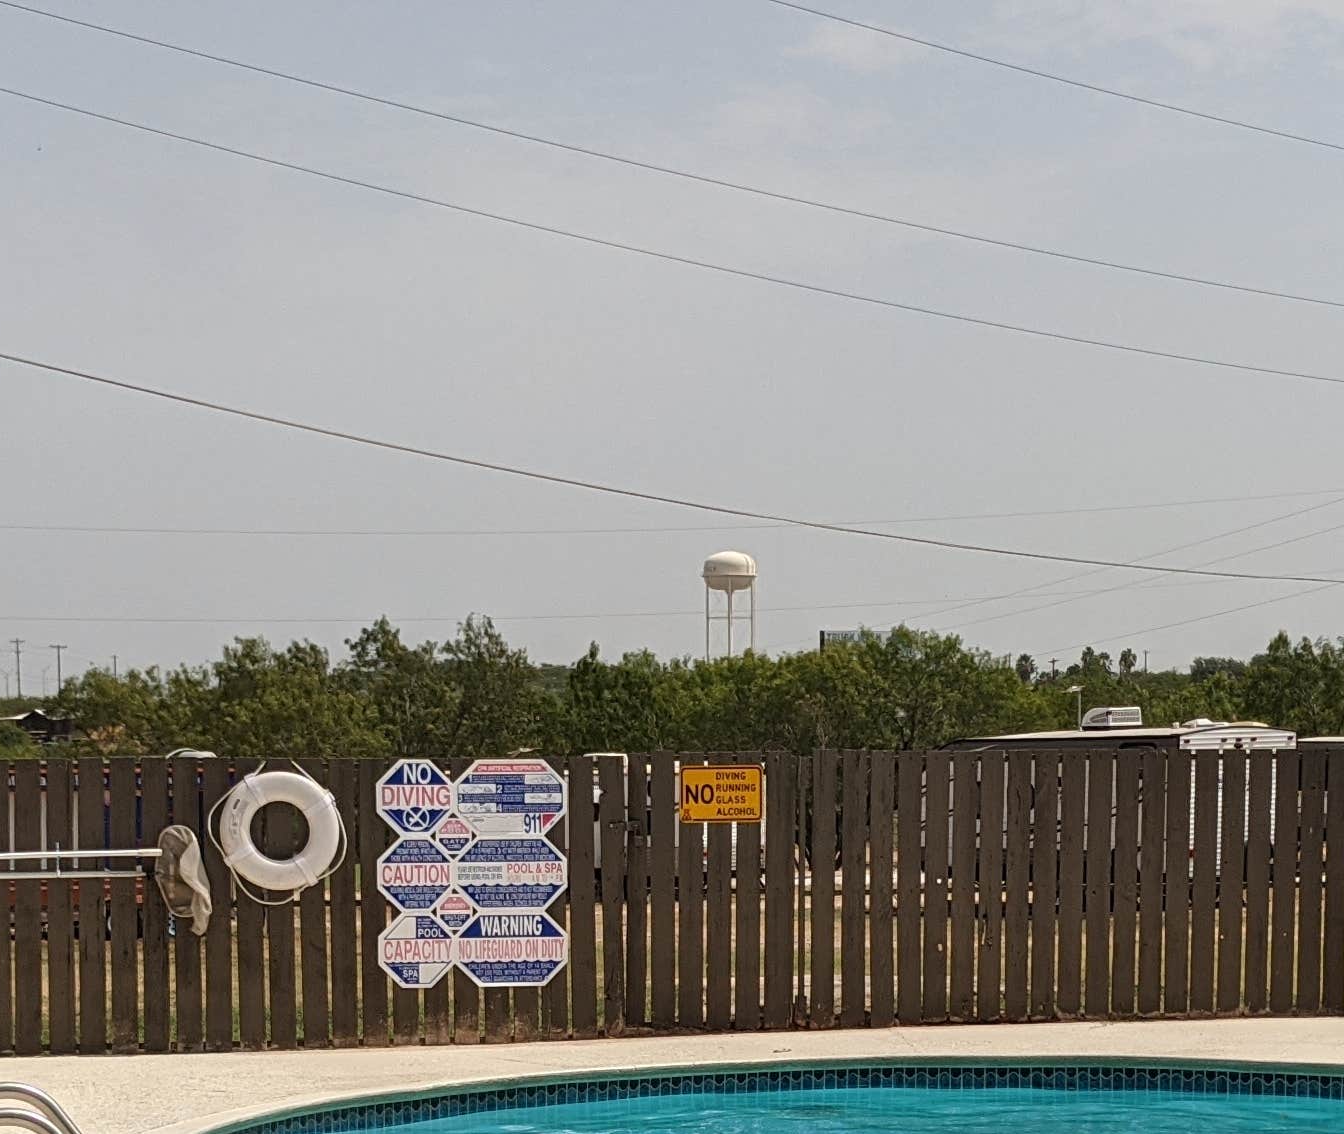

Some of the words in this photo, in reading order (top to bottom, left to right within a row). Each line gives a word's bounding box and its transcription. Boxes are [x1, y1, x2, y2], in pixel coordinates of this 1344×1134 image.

[403, 763, 432, 785] NO
[716, 772, 746, 780] DIVING
[496, 785, 503, 793] 2
[685, 784, 714, 804] NO
[716, 784, 757, 792] RUNNING
[381, 786, 451, 806] DIVING
[716, 796, 746, 804] GLASS
[716, 808, 757, 816] ALCOHOL
[523, 814, 542, 833] 911
[382, 865, 450, 884] CAUTION
[507, 863, 533, 873] POOL
[535, 863, 543, 873] &
[544, 862, 563, 872] SPA
[417, 928, 444, 938] POOL
[479, 915, 543, 936] WARNING
[384, 940, 453, 960] CAPACITY
[458, 939, 472, 960] NO
[474, 939, 523, 959] LIFEGUARD
[524, 939, 538, 959] ON
[541, 939, 564, 958] DUTY
[402, 969, 419, 978] SPA
